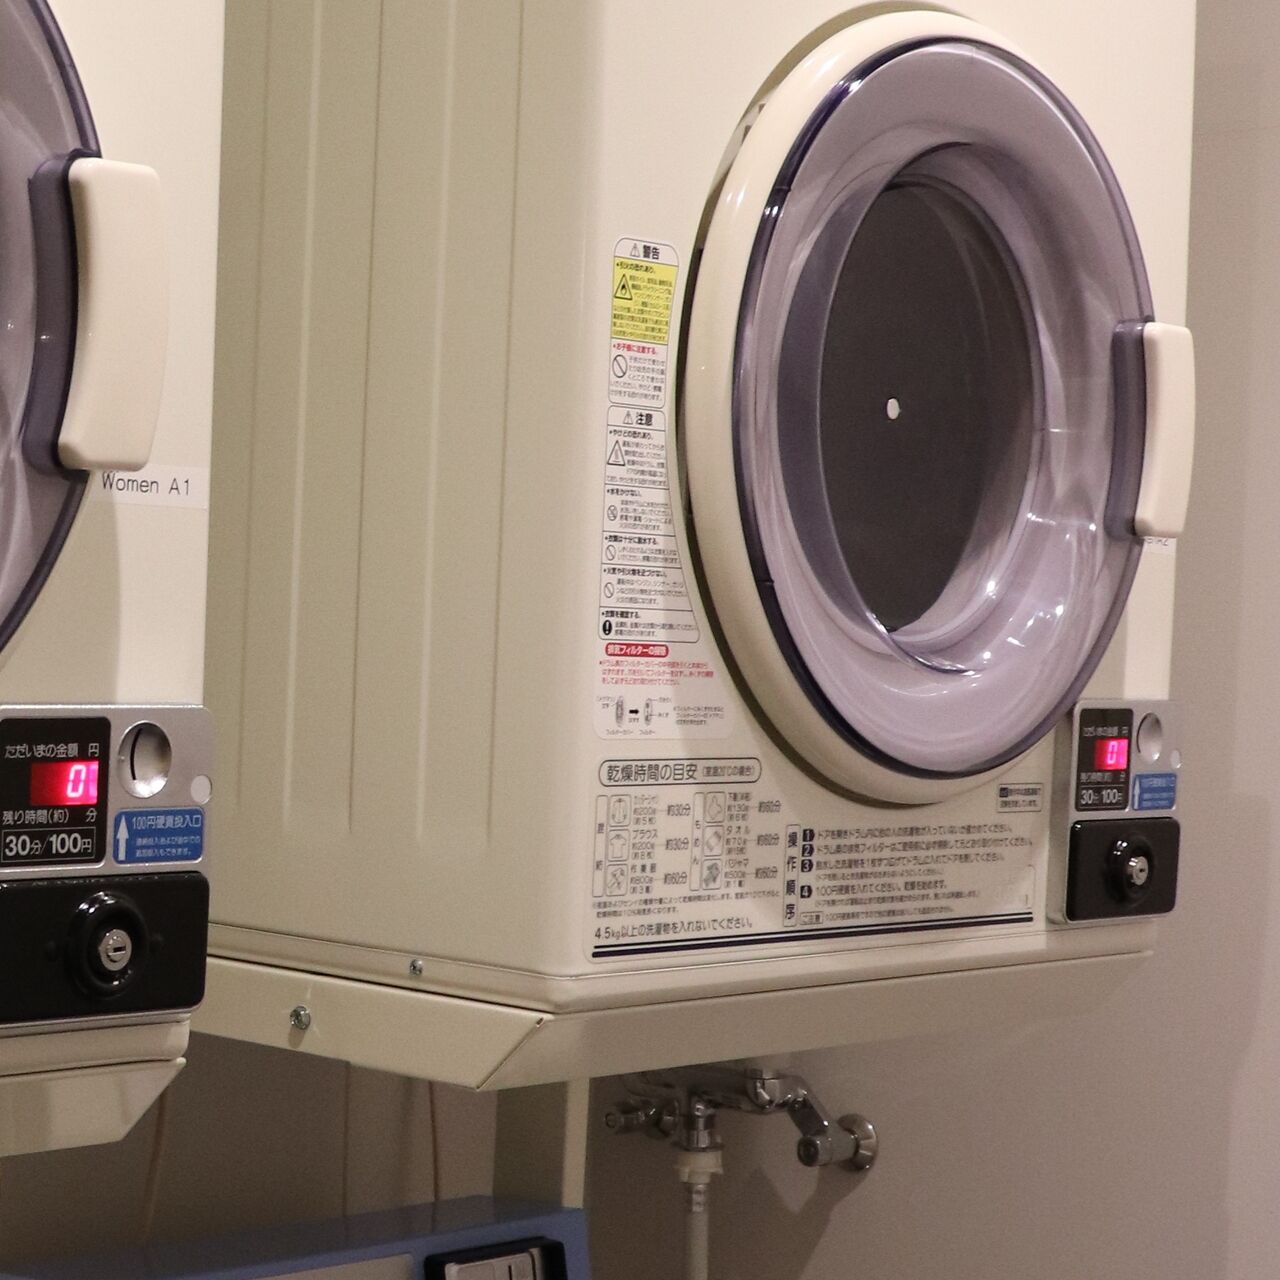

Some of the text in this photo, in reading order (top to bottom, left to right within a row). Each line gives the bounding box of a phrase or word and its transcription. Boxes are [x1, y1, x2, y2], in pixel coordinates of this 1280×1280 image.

[102, 470, 159, 493] Women
[5, 743, 78, 758] ただいまの金額
[88, 742, 100, 757] 円
[1107, 741, 1118, 765] 0
[66, 764, 87, 798] 0
[607, 763, 698, 783] 乾燥時間の目安
[85, 808, 97, 822] 分
[5, 832, 93, 856] 30分/100円
